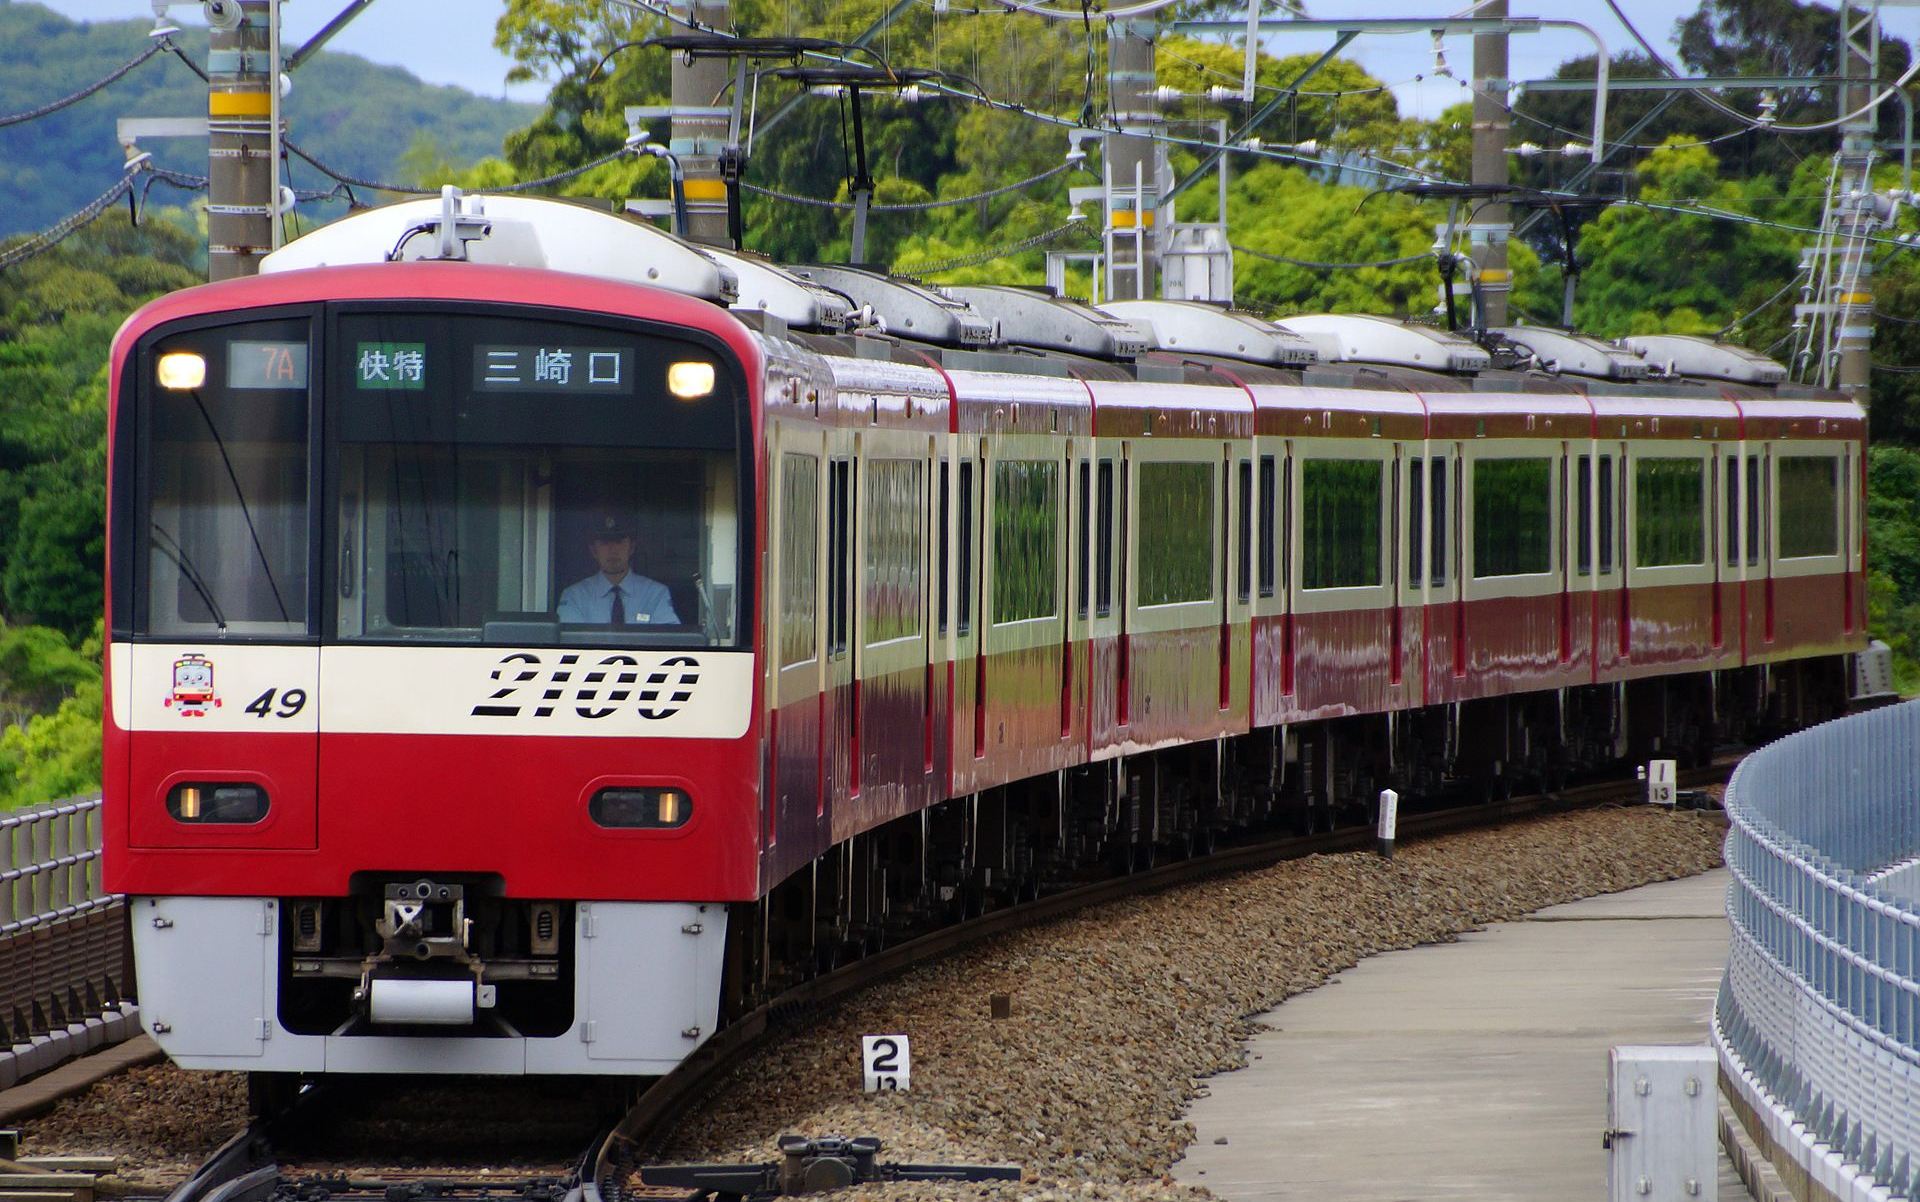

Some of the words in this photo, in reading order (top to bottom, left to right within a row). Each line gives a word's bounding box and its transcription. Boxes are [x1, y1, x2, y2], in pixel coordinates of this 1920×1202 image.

[262, 347, 294, 380] 7A
[358, 350, 424, 381] 快特
[484, 348, 620, 384] 三崎口
[244, 687, 307, 718] 49
[470, 653, 700, 720] 2100
[1659, 763, 1665, 782] 1
[1654, 787, 1669, 801] 13
[872, 1038, 899, 1072] 2
